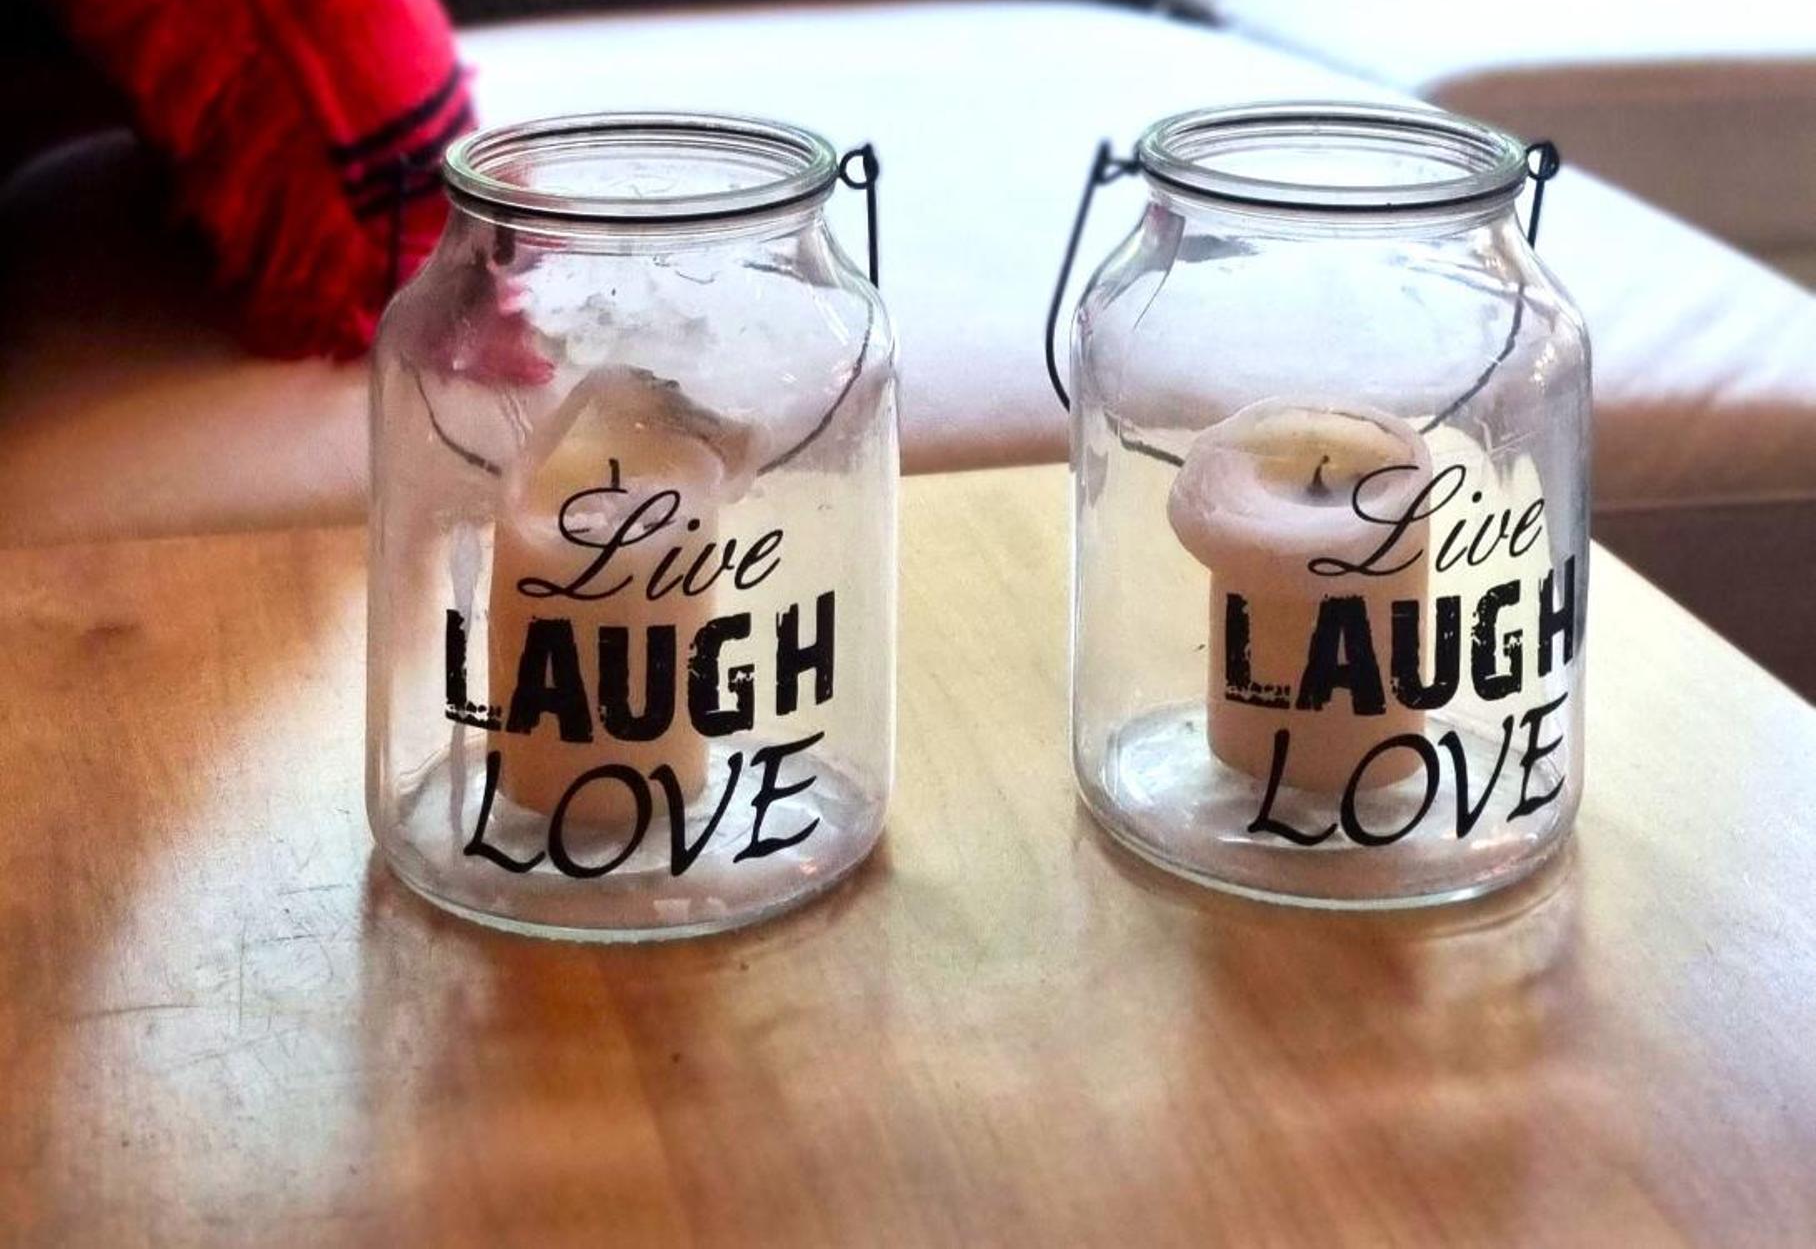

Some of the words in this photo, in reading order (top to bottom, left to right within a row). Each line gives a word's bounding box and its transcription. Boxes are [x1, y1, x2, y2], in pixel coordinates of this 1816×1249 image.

[517, 487, 784, 601] Live
[1308, 464, 1545, 577] Live
[445, 590, 836, 744] LAUGH
[1225, 554, 1575, 716] LAUGH
[463, 731, 825, 879] LOVE
[1247, 692, 1568, 847] LOVE
